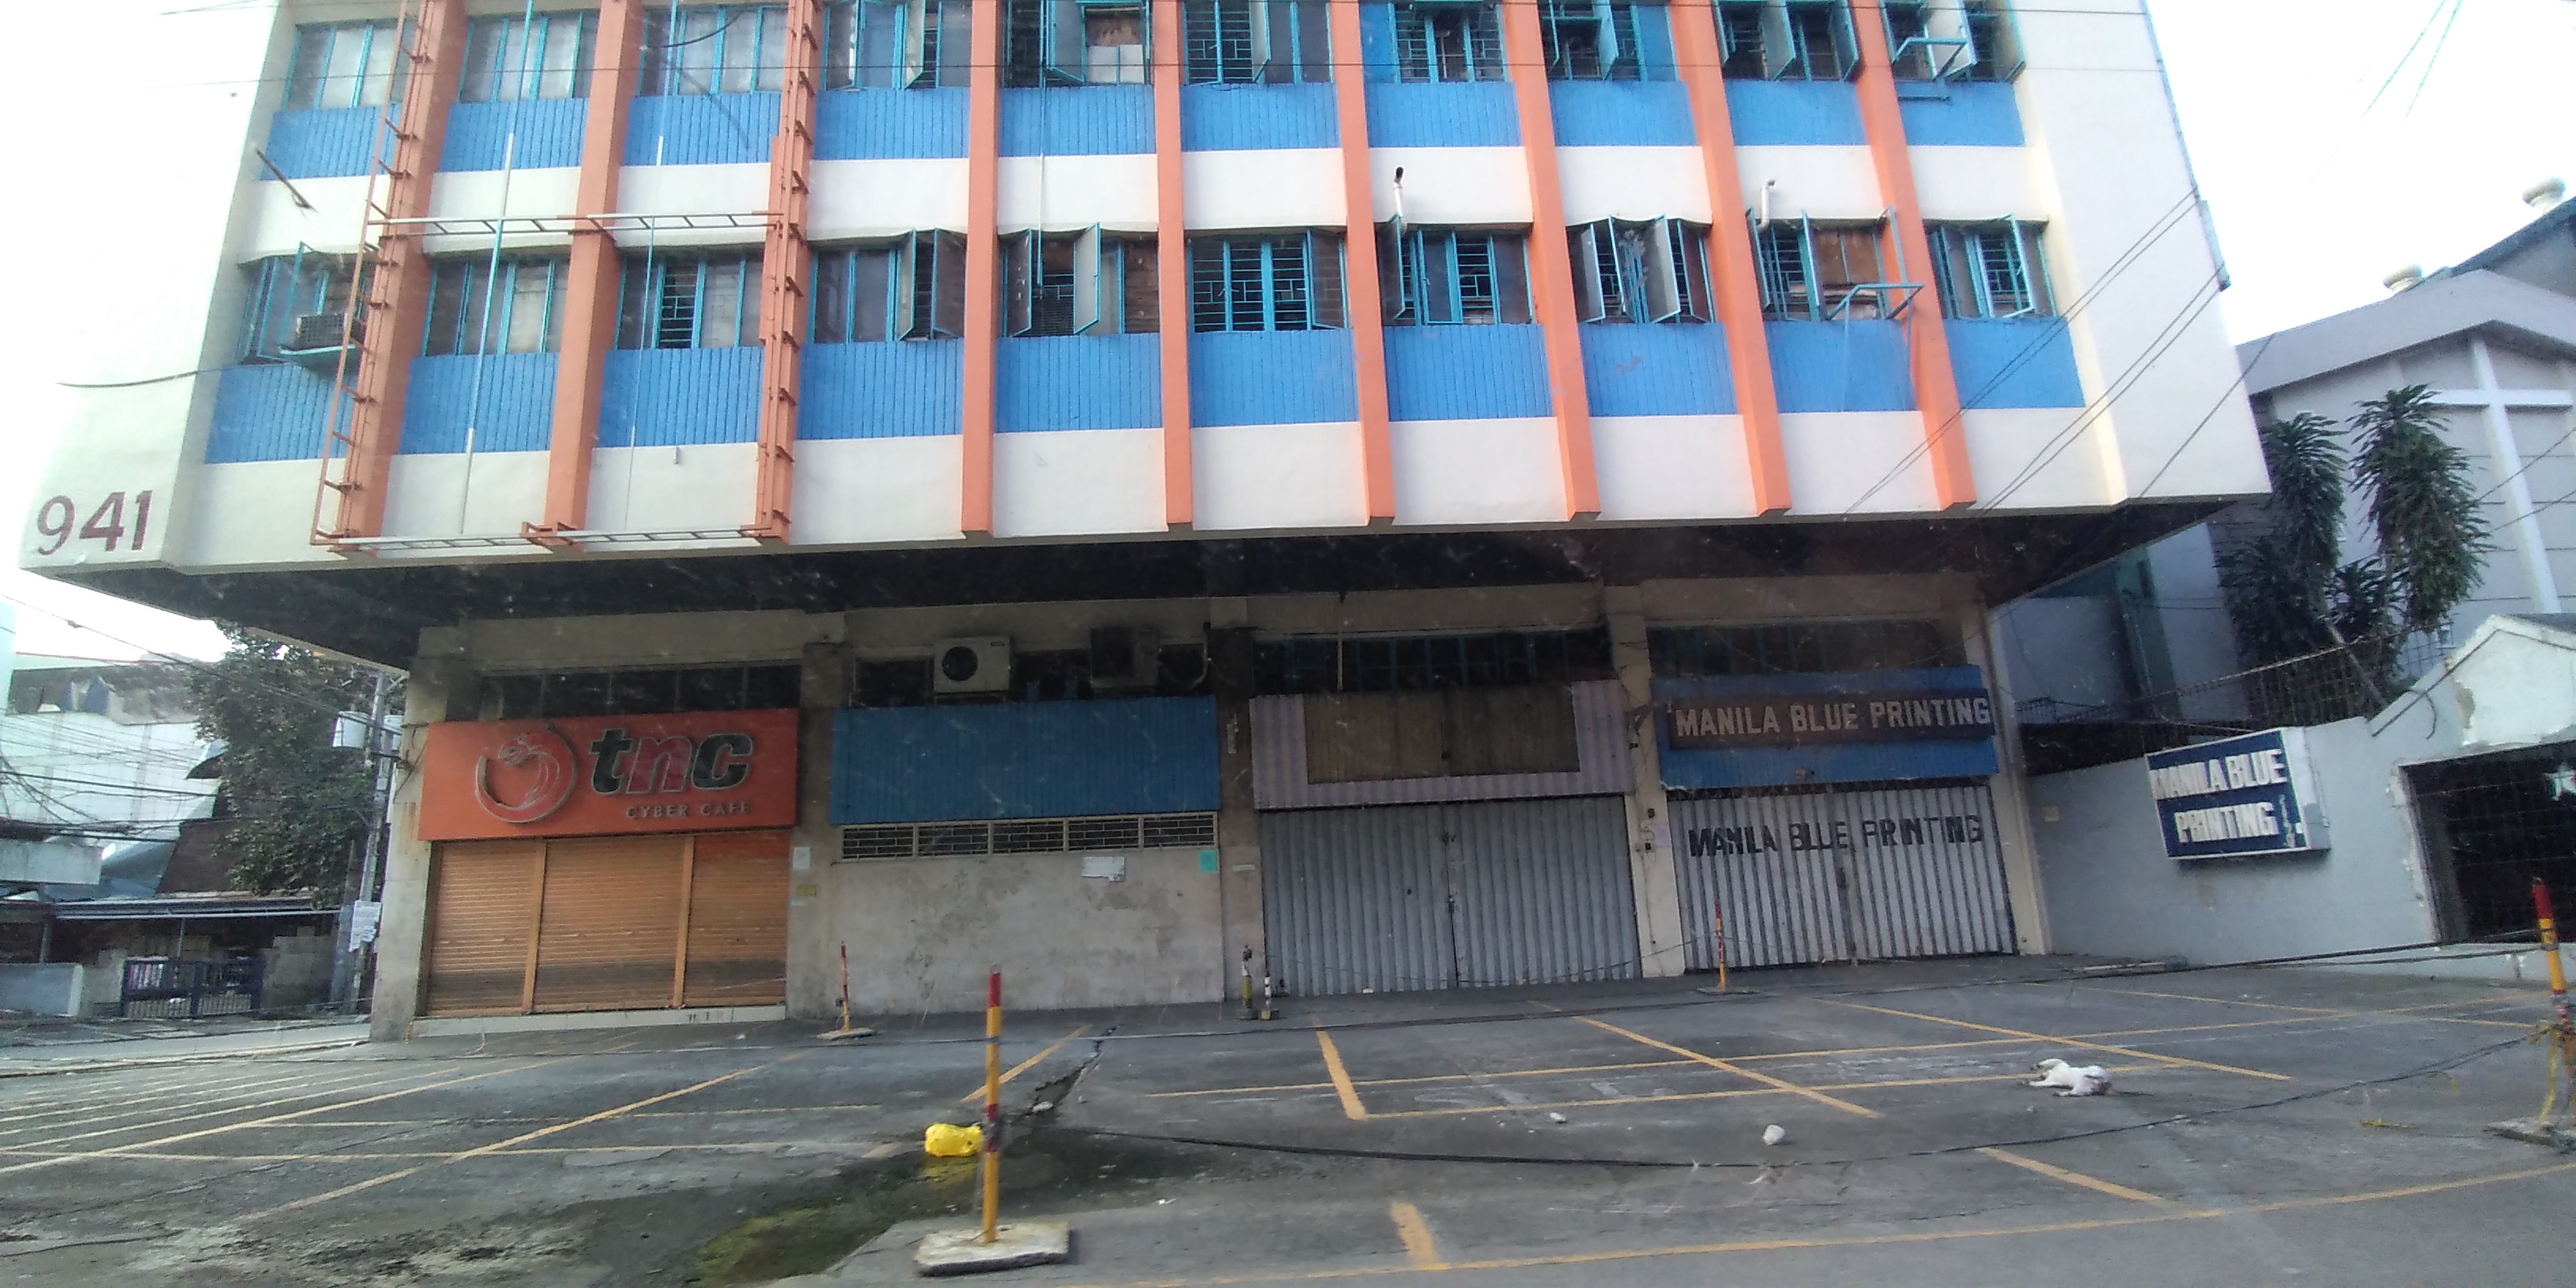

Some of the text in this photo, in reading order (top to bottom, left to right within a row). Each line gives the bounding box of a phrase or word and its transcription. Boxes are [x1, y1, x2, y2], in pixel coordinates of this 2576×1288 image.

[37, 489, 153, 555] 941
[1676, 697, 1993, 737] MANILA BLUE PRINTING
[589, 727, 754, 796] tnc
[2148, 748, 2288, 800] MANILA BLUE
[626, 801, 751, 820] CYBER CAFE
[2174, 802, 2279, 843] PRINTING
[1688, 814, 1983, 858] MANILA BLUE PRINTING
